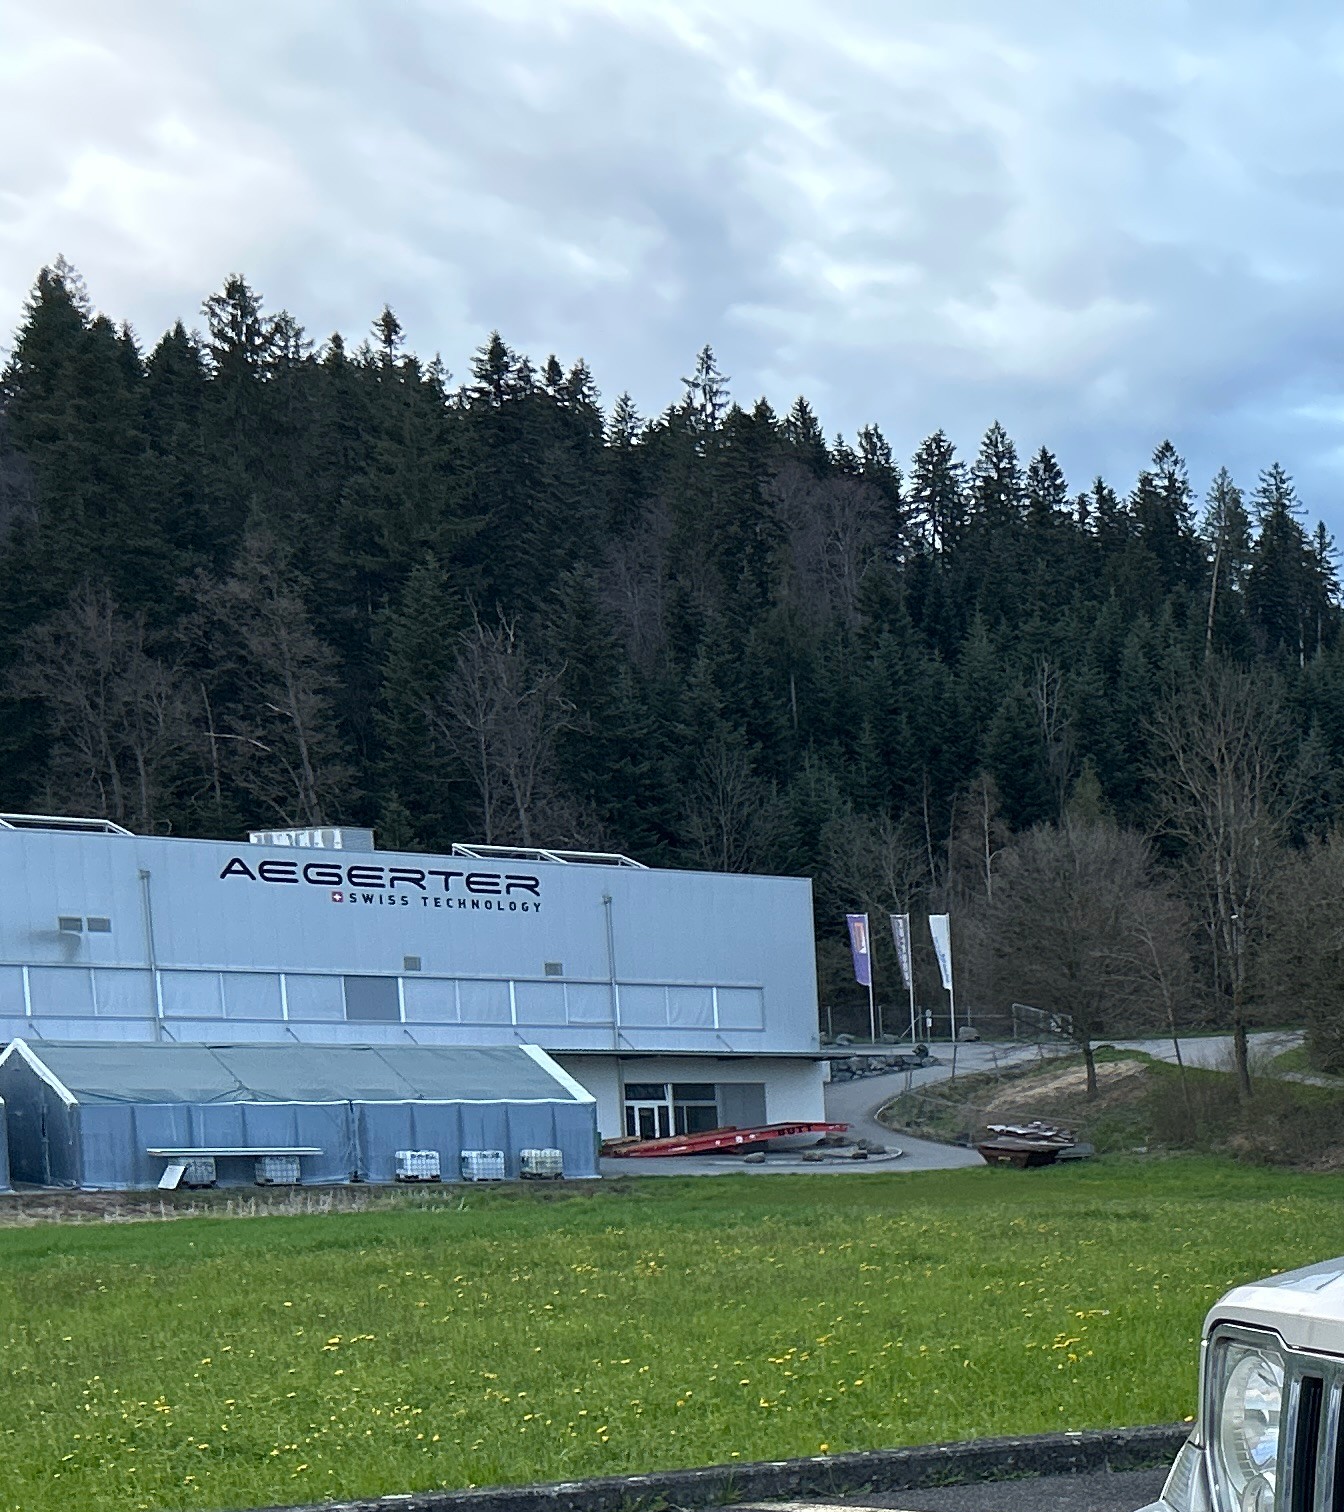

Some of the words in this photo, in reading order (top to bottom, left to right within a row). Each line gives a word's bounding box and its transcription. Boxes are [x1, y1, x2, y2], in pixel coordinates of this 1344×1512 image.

[219, 857, 541, 897] AEGERTER
[349, 893, 410, 906] SWISS
[421, 896, 542, 913] TECHNOLOGY
